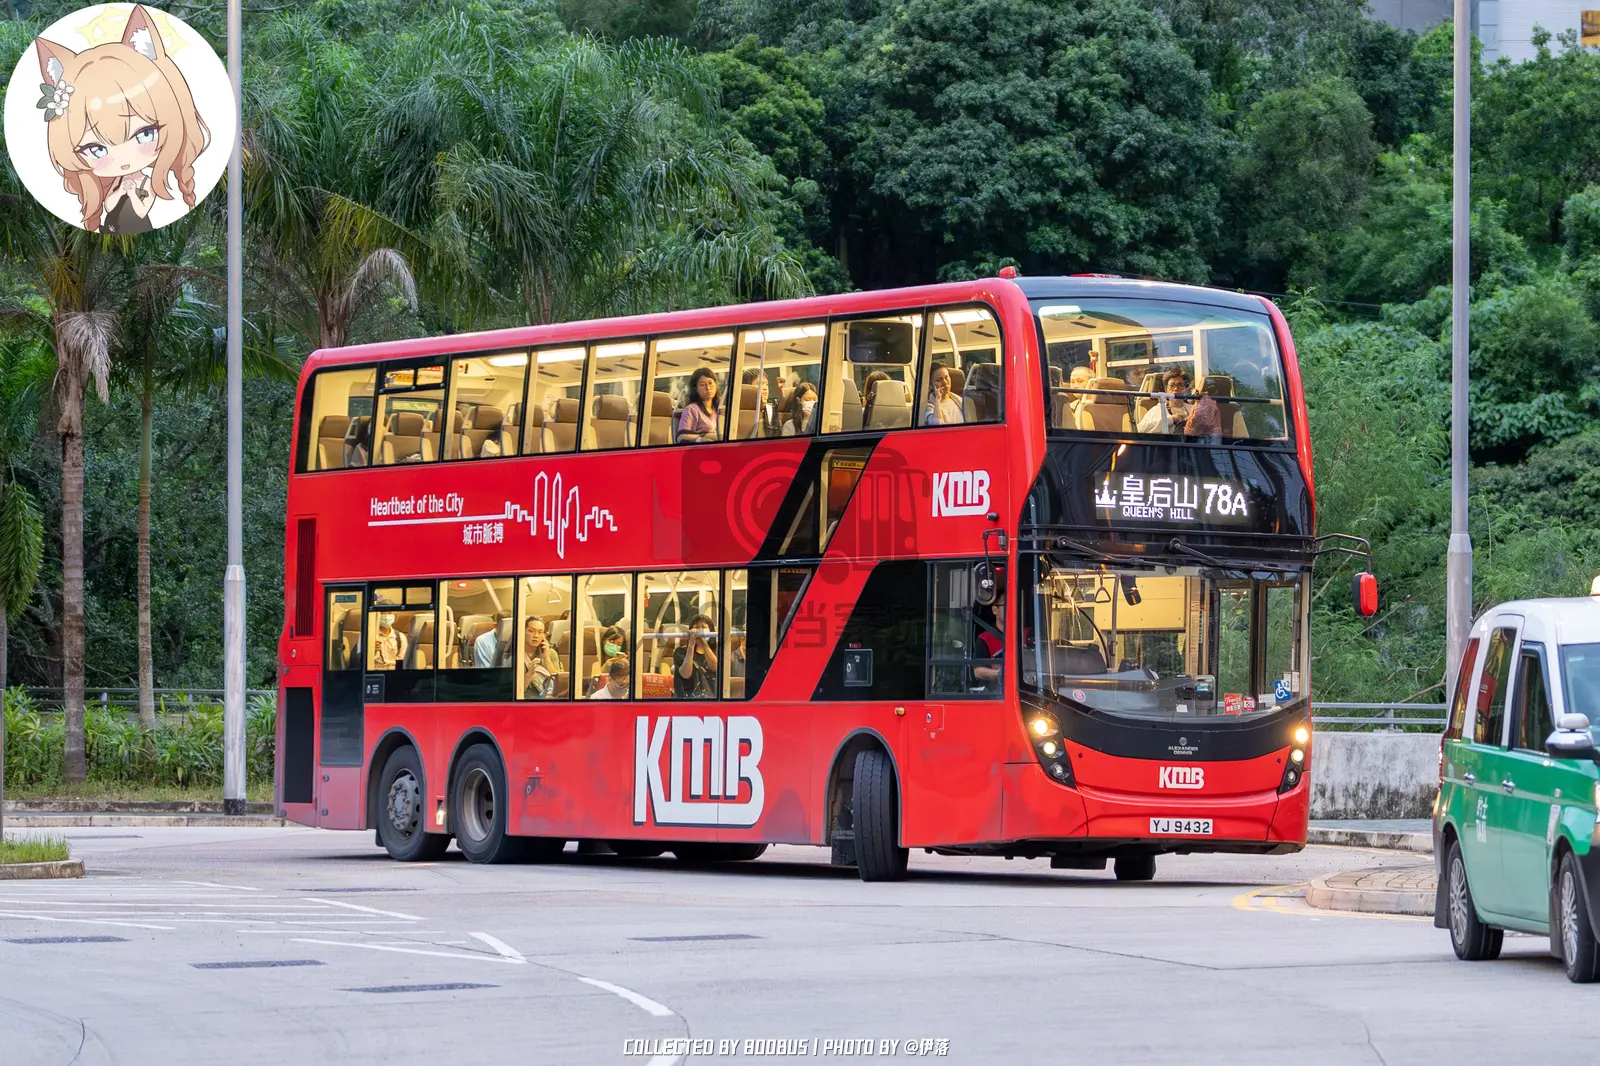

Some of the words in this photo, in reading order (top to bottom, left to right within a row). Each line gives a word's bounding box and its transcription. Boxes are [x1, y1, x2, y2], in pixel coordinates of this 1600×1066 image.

[370, 496, 415, 516] Heartbeat
[417, 495, 428, 514] of
[429, 494, 444, 513] the
[446, 492, 464, 516] City
[932, 470, 990, 517] KMB
[1119, 474, 1198, 509] 皇后山
[1203, 483, 1248, 516] 78A
[1122, 506, 1164, 519] QUEEN'S
[1170, 508, 1194, 520] HILL
[462, 522, 504, 545] 城市脈搏
[634, 715, 764, 827] KMB
[1159, 766, 1204, 789] KMB
[1153, 819, 1170, 833] YJ
[1174, 820, 1210, 834] 9432
